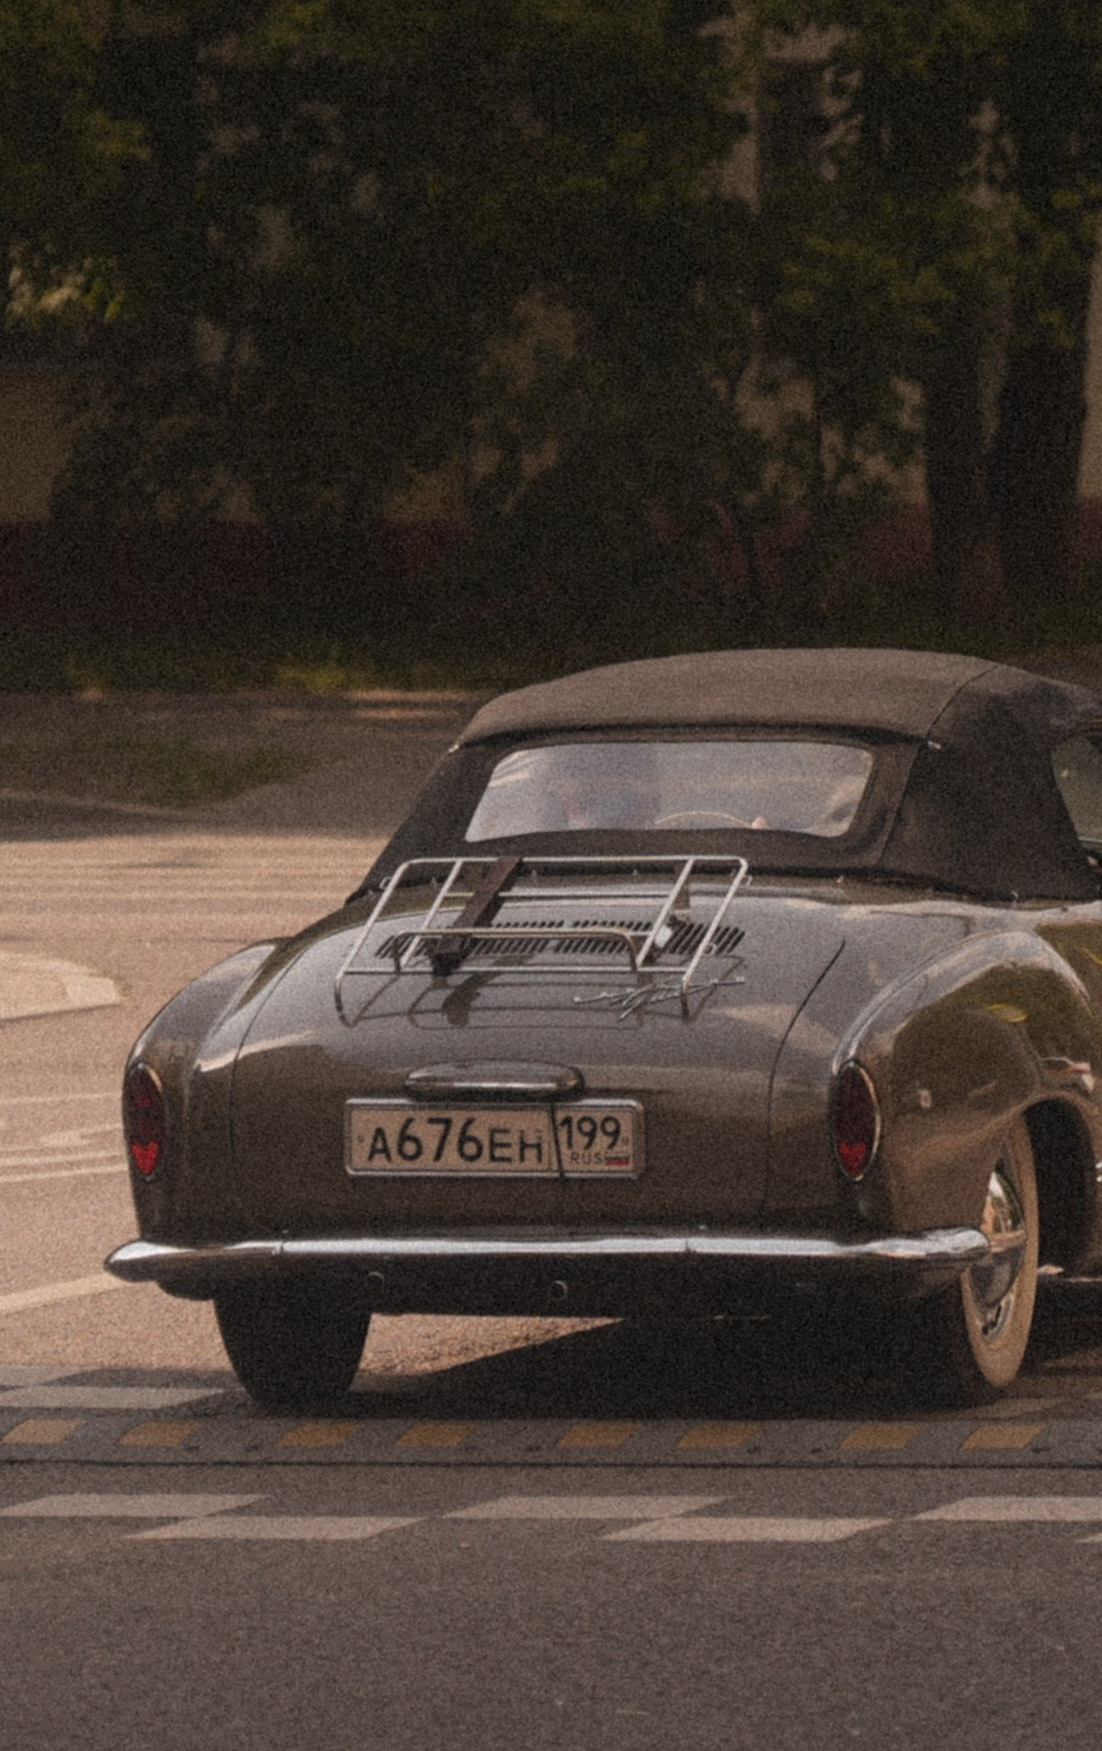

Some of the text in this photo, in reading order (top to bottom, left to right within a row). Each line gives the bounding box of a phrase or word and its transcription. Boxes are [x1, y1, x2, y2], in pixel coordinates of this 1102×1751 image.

[367, 1115, 622, 1163] А676ЕН 199
[570, 1152, 603, 1165] RUS
